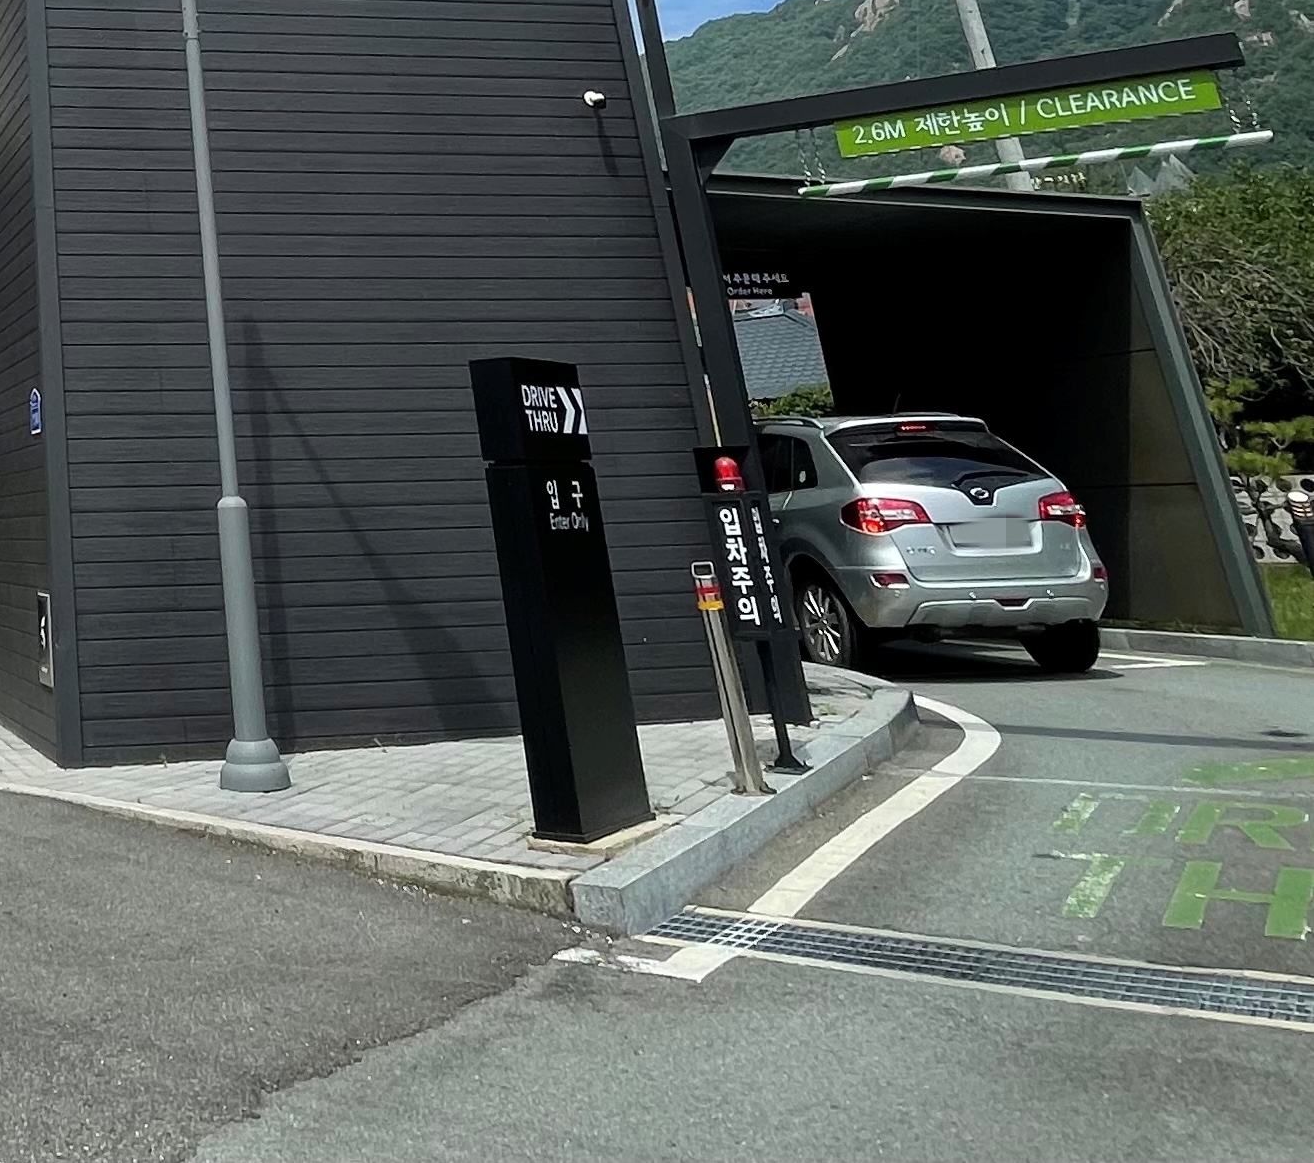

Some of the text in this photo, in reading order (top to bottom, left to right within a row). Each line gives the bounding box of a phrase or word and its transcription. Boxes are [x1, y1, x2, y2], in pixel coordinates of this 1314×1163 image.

[853, 122, 906, 145] 2.6M
[915, 103, 1009, 137] 제한높이
[1036, 79, 1195, 119] CLEARANCE
[521, 385, 557, 408] DRIVE
[525, 409, 559, 433] THRU
[550, 512, 589, 532] Enter Only
[719, 507, 761, 626] 입차주의
